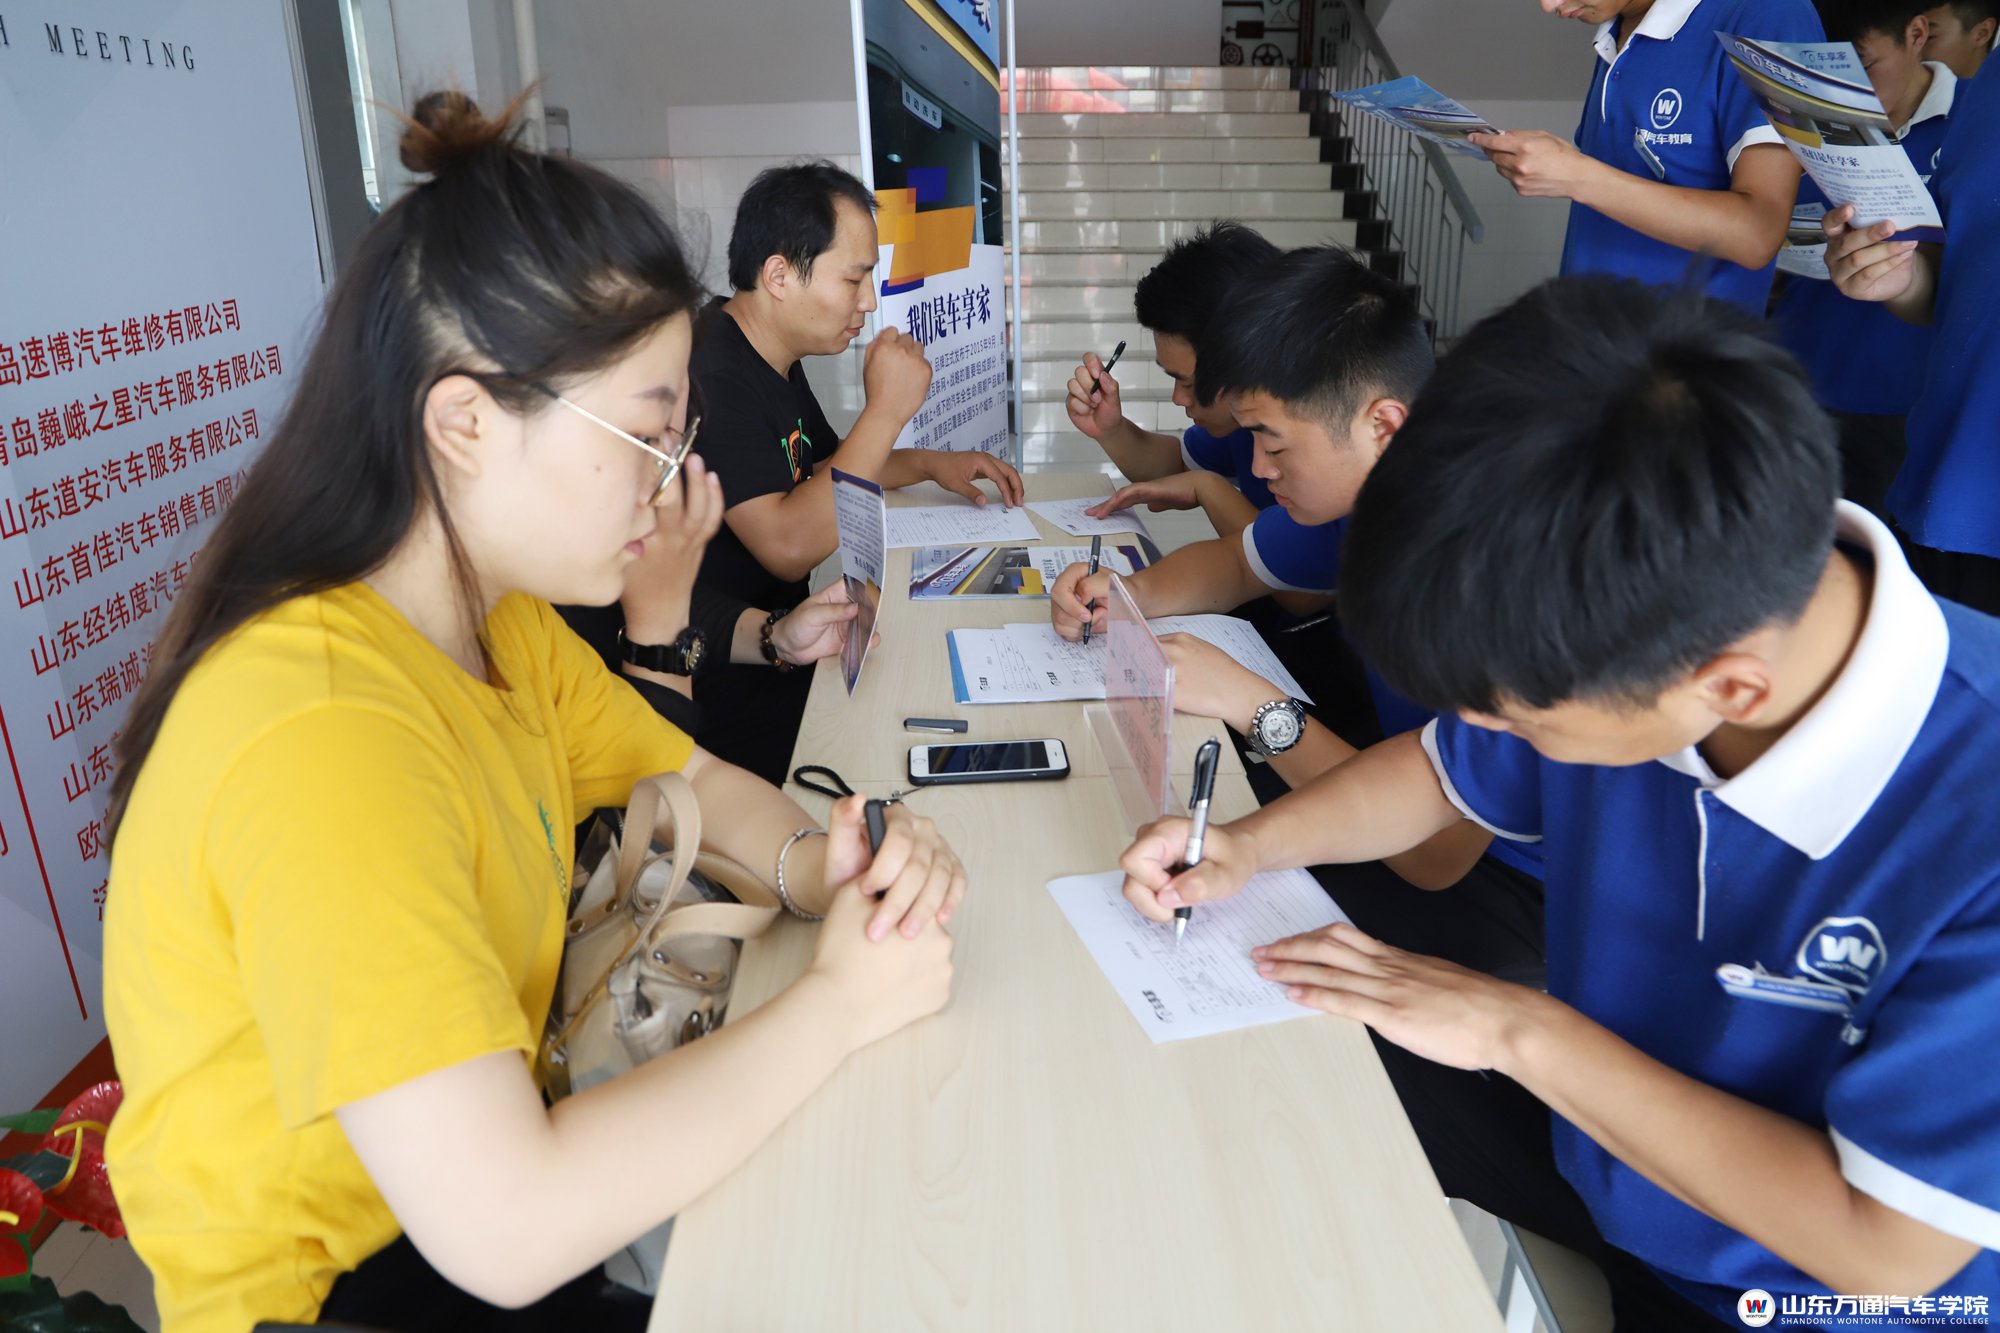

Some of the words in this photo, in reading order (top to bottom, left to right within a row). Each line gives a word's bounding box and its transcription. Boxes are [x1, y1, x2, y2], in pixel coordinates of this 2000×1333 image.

[44, 22, 195, 70] MEETING
[1657, 98, 1676, 115] W
[906, 283, 991, 347] 我们是车享家
[0, 408, 260, 540] 山东道安汽车服务有限公司
[1820, 933, 1877, 970] W
